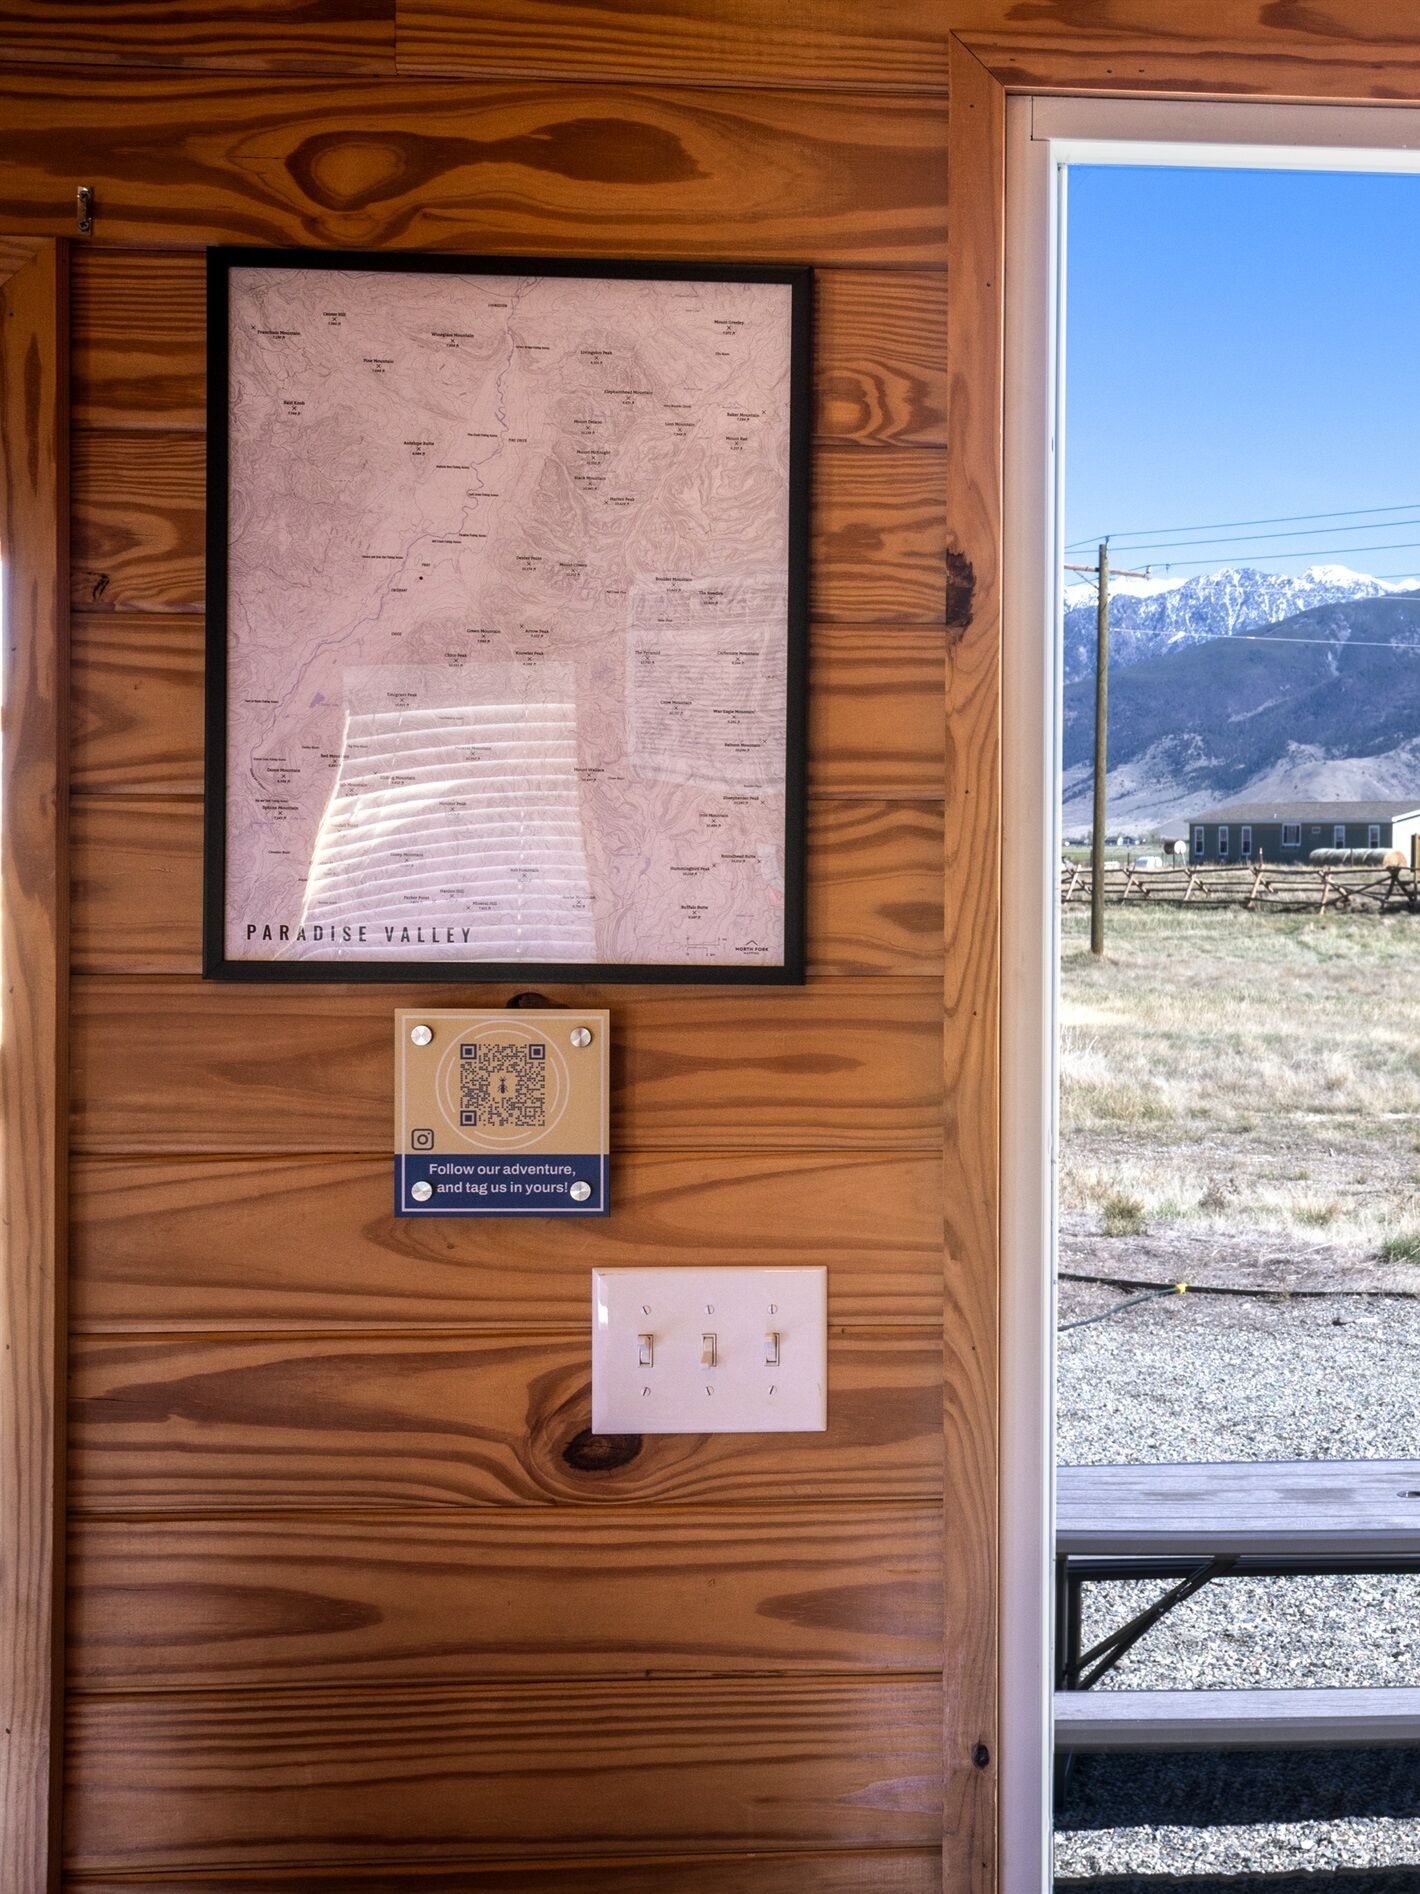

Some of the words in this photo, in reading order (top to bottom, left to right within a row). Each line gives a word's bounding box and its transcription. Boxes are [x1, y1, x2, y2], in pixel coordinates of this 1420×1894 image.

[246, 924, 367, 942] PARADISE
[384, 926, 471, 943] VALLEY
[429, 1163, 475, 1175] Follow
[477, 1165, 501, 1175] our
[503, 1163, 576, 1177] adventure,
[437, 1181, 463, 1193] and
[465, 1182, 488, 1196] tag
[490, 1184, 507, 1193] us
[510, 1181, 523, 1193] in
[525, 1182, 568, 1196] yours!
